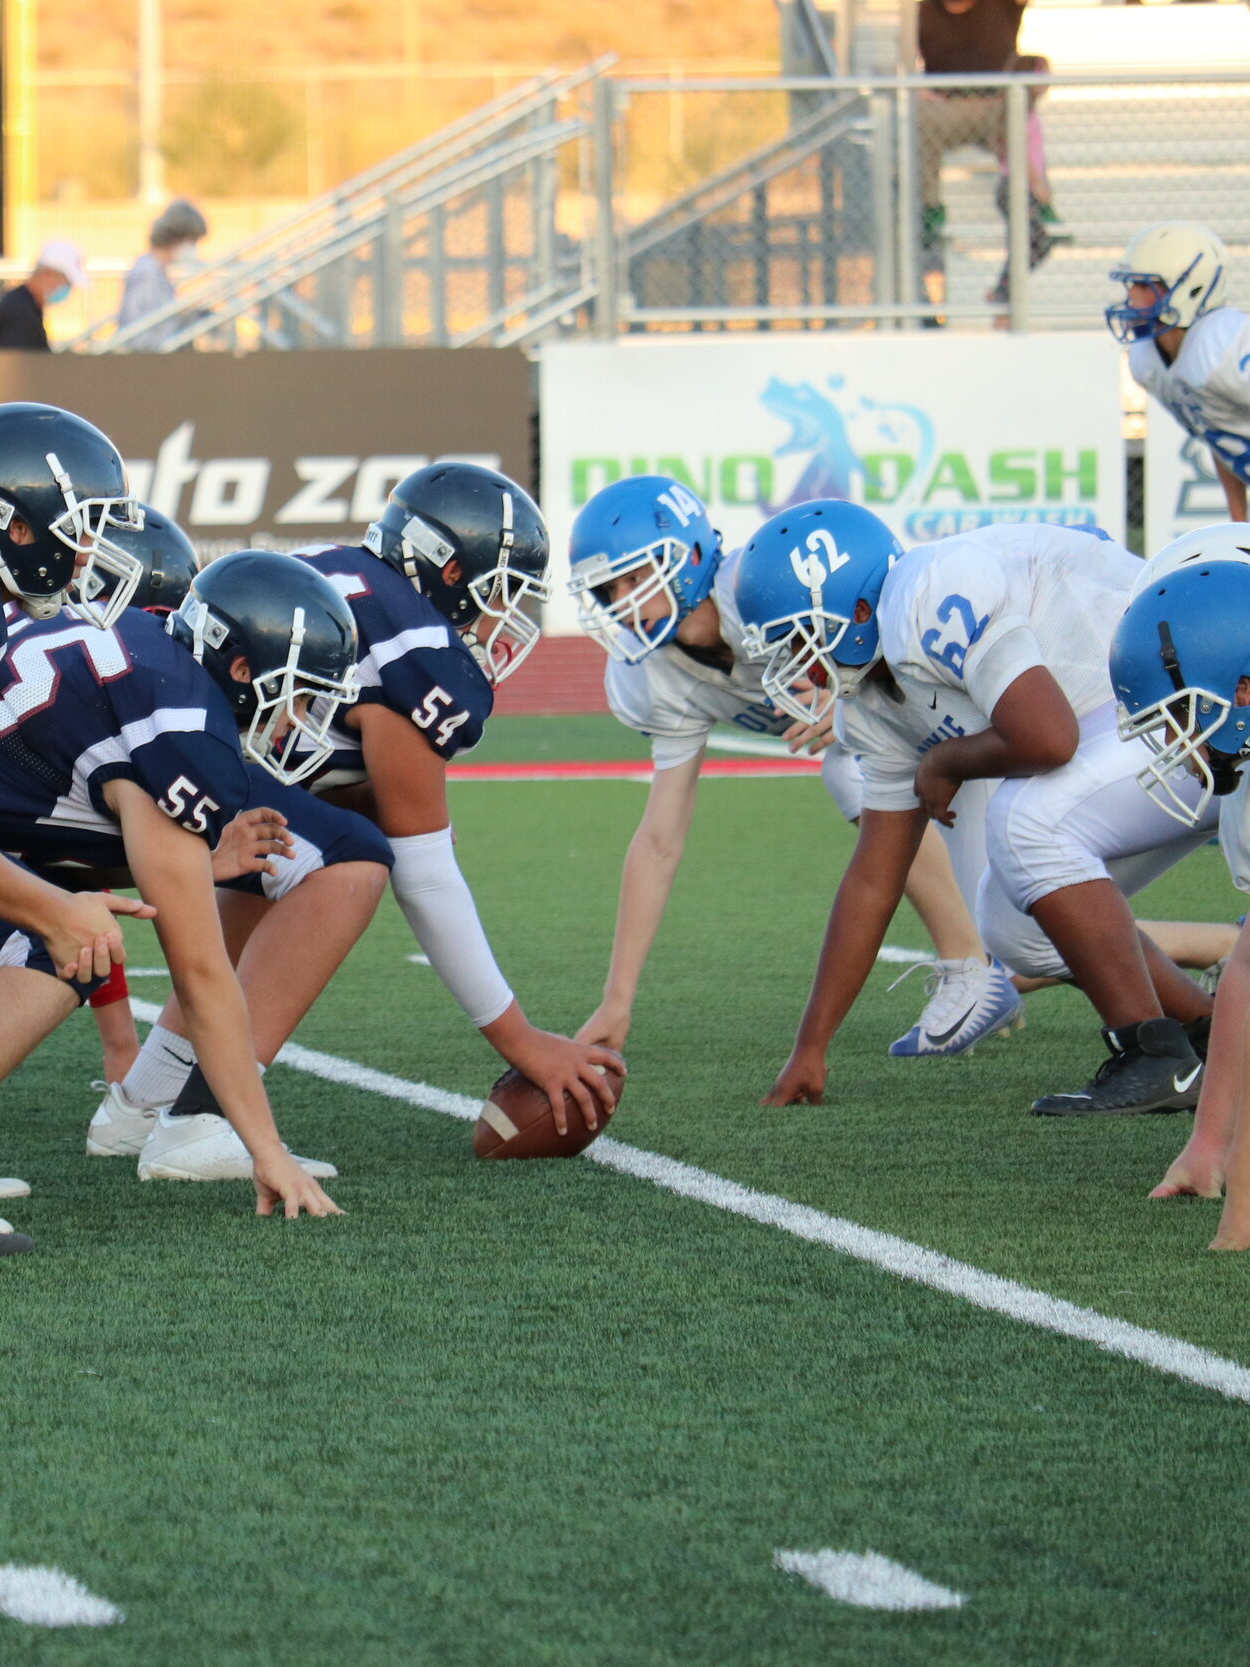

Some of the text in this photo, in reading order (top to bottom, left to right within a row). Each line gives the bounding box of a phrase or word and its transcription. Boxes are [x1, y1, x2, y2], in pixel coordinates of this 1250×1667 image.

[273, 453, 500, 525] zo
[862, 448, 1098, 503] DASH
[657, 484, 701, 528] 14
[790, 529, 851, 589] 62
[920, 593, 990, 681] 62
[411, 685, 471, 748] 54
[157, 775, 221, 834] 55
